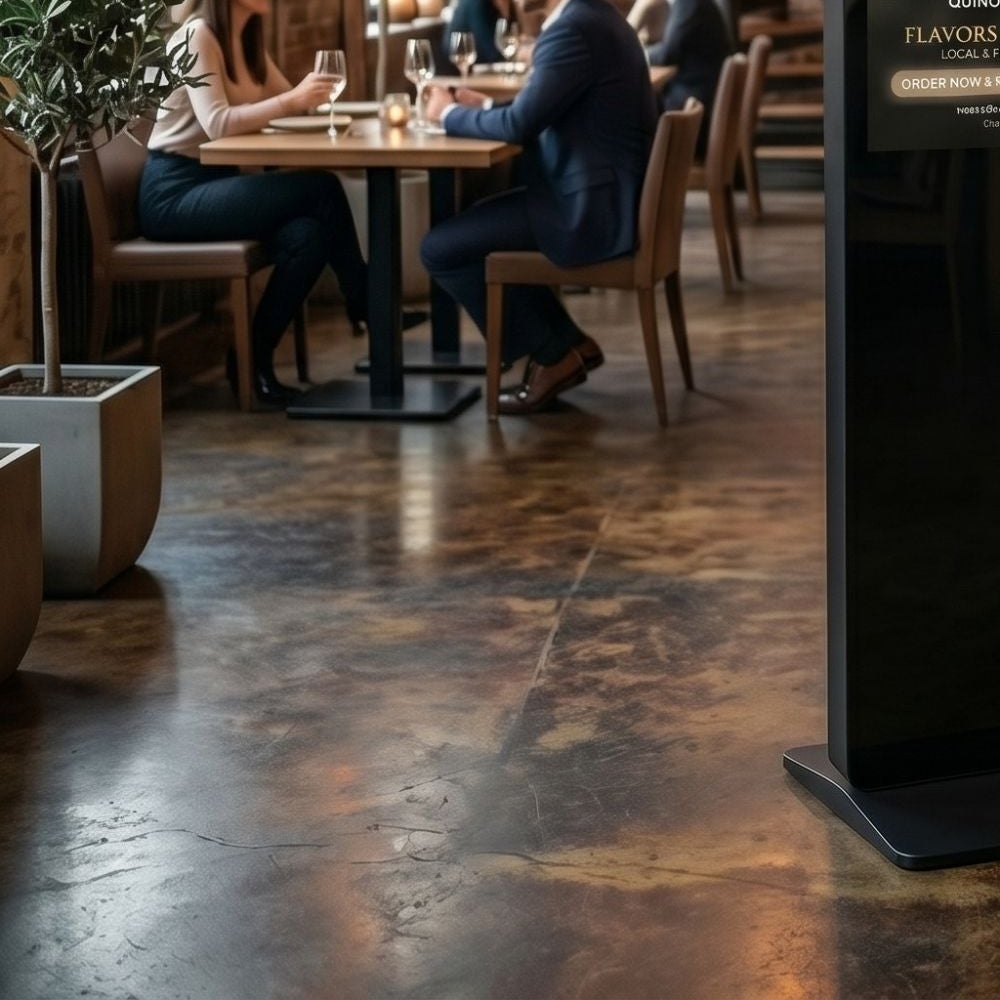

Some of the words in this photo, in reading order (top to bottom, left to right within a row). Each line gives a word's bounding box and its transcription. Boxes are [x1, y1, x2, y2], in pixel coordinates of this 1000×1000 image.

[905, 25, 997, 44] FLAVORS
[941, 48, 979, 59] LOCAL
[982, 48, 990, 58] &
[901, 77, 946, 90] ORDER
[949, 76, 981, 89] NOW
[984, 77, 993, 87] &
